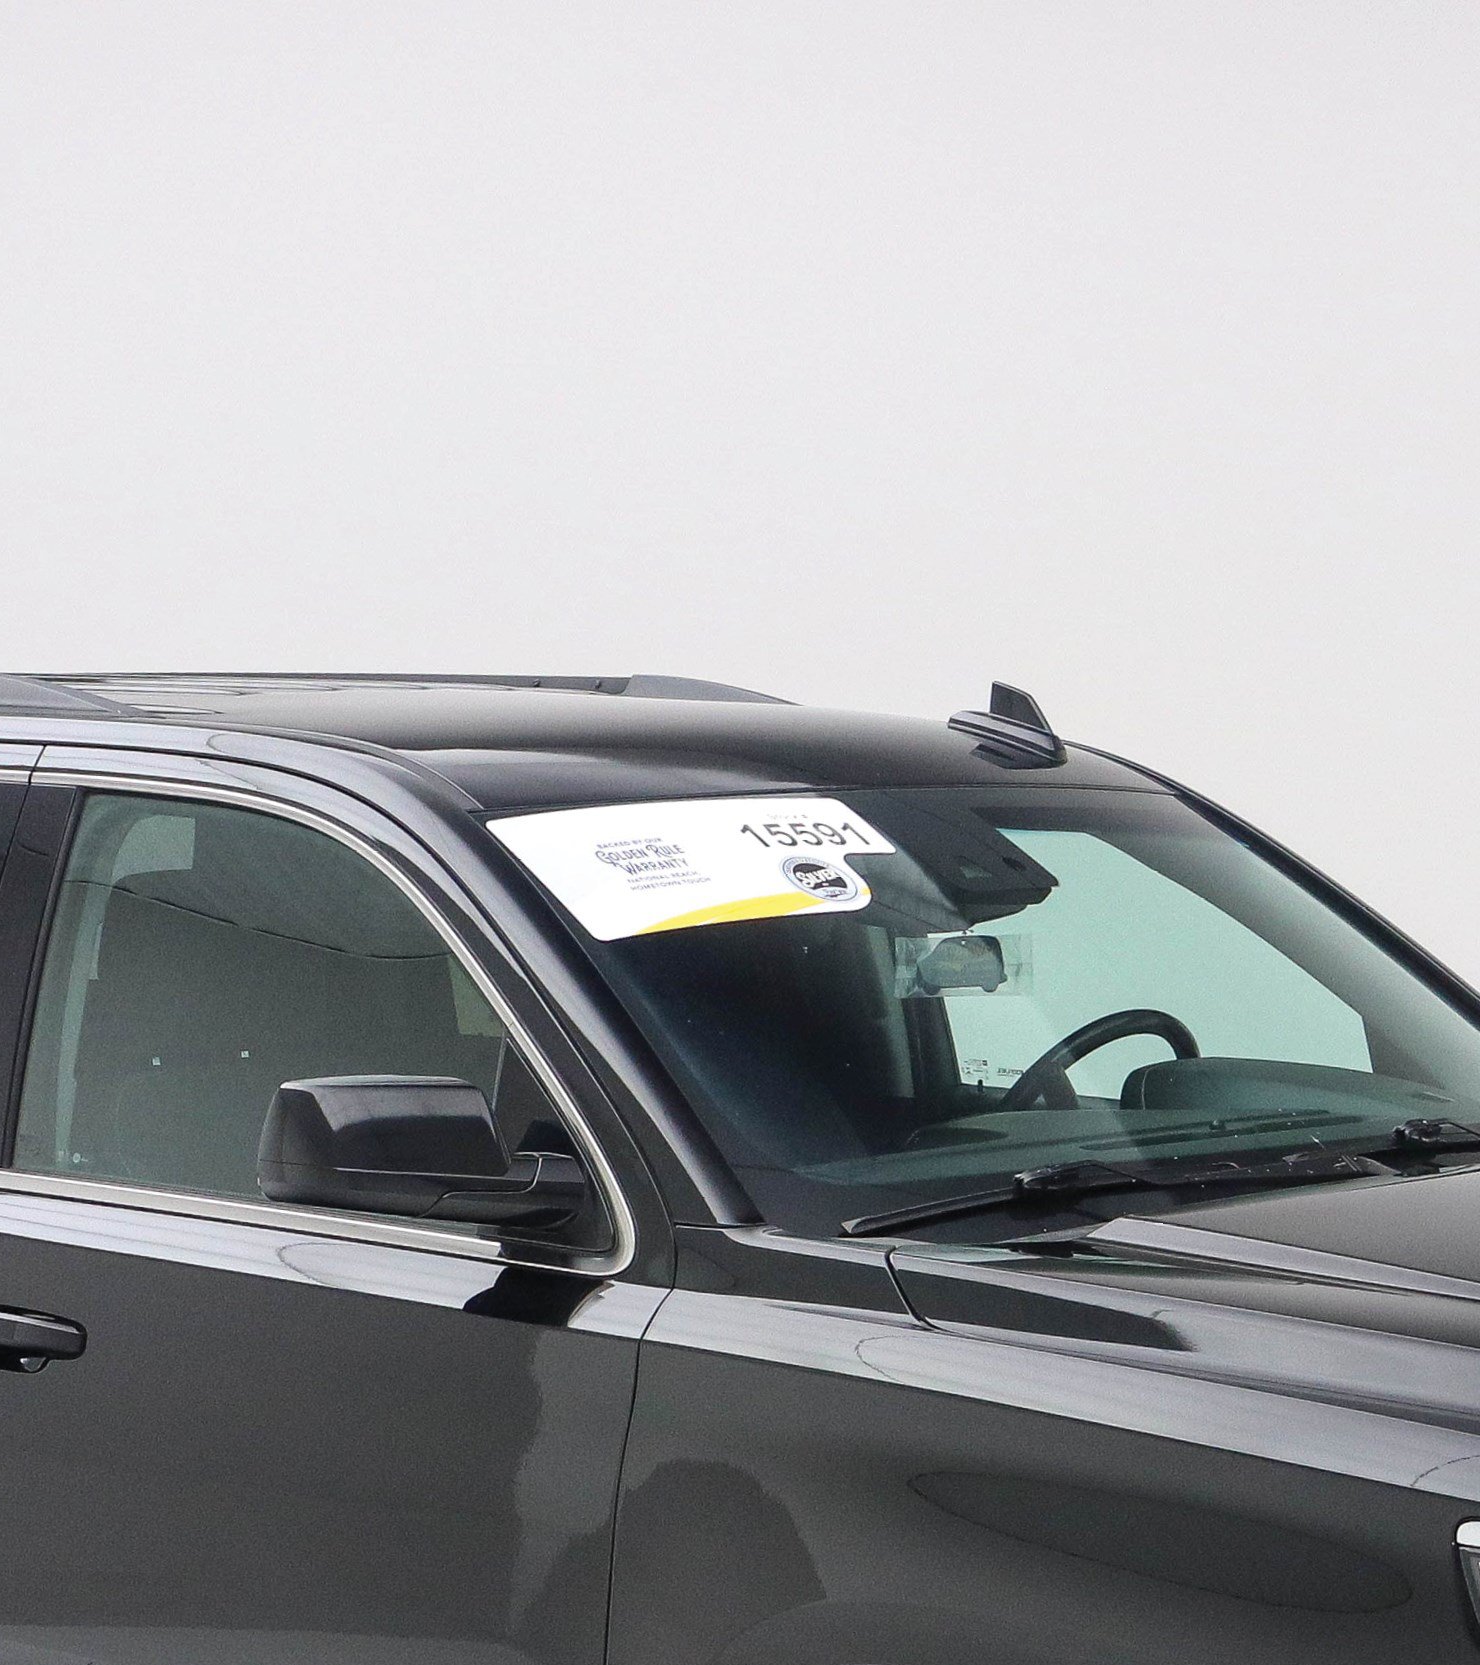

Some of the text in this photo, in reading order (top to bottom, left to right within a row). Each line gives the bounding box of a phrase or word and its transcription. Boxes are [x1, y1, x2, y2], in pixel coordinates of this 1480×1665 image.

[740, 822, 870, 848] 15591
[595, 843, 686, 867] GOLDEN RULE
[620, 857, 688, 876] WARRANTY
